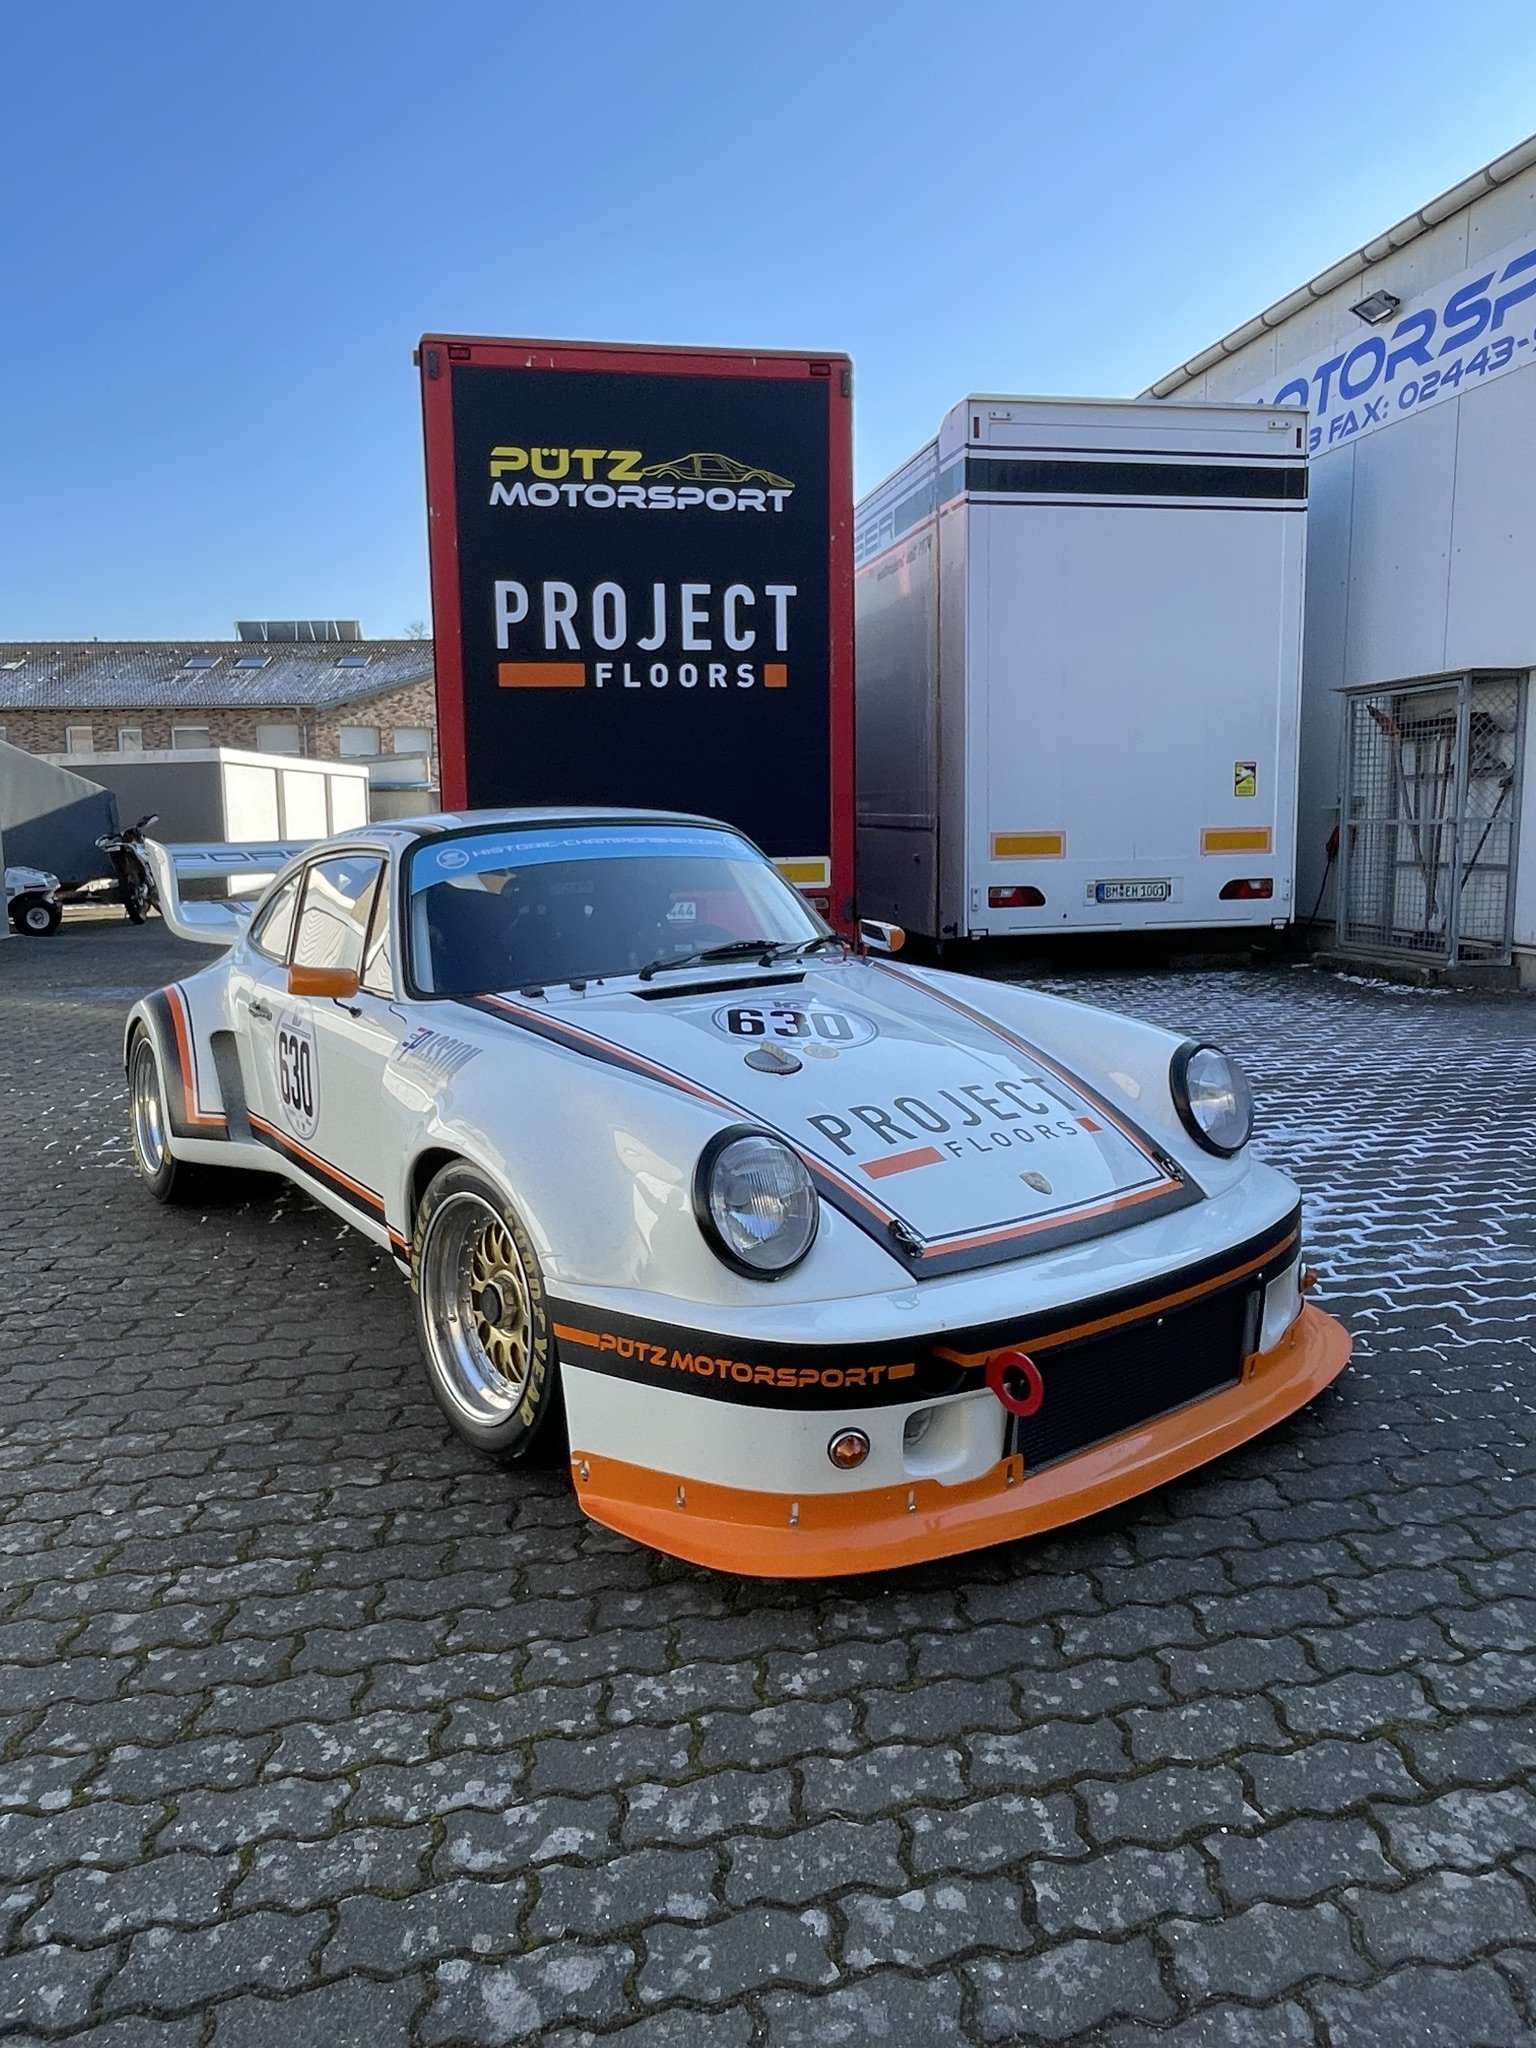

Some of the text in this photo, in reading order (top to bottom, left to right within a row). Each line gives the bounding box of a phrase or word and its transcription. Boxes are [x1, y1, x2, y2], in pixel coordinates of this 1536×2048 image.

[1328, 395, 1389, 444] FAX:
[1398, 327, 1536, 410] 02443-
[490, 446, 643, 481] PÜTZ
[489, 482, 793, 512] MOTORSPORT
[495, 580, 798, 651] PROJECT
[595, 663, 755, 688] FLOORS
[172, 850, 304, 862] POR
[1140, 885, 1164, 897] 1001
[727, 1008, 854, 1040] 630
[279, 1030, 313, 1118] 630
[807, 1077, 1076, 1156] PROJECT
[944, 1121, 1077, 1158] FLOORS
[670, 1350, 886, 1388] MOTORSPORT
